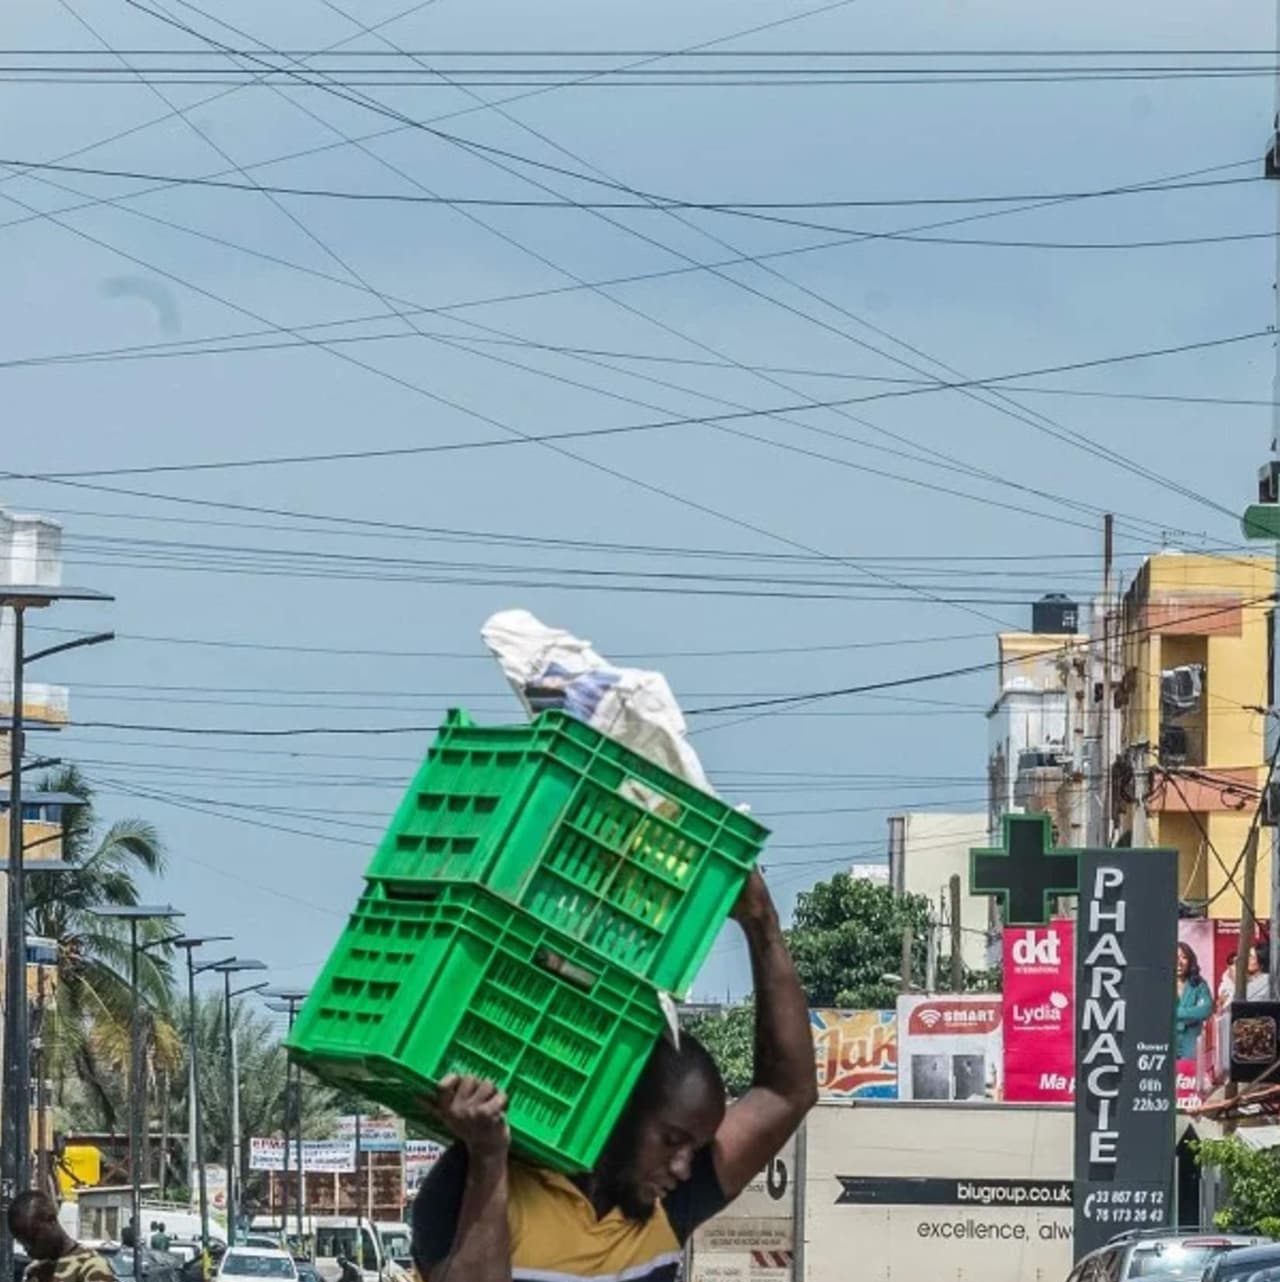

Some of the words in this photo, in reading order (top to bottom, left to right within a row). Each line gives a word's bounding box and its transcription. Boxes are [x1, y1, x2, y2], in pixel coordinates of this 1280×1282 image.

[1013, 1003, 1061, 1025] Lydia
[1081, 866, 1127, 1163] PHARMACIE
[1137, 1054, 1166, 1071] 6/7
[1039, 1073, 1066, 1090] Ma
[916, 1219, 1030, 1241] excellence,
